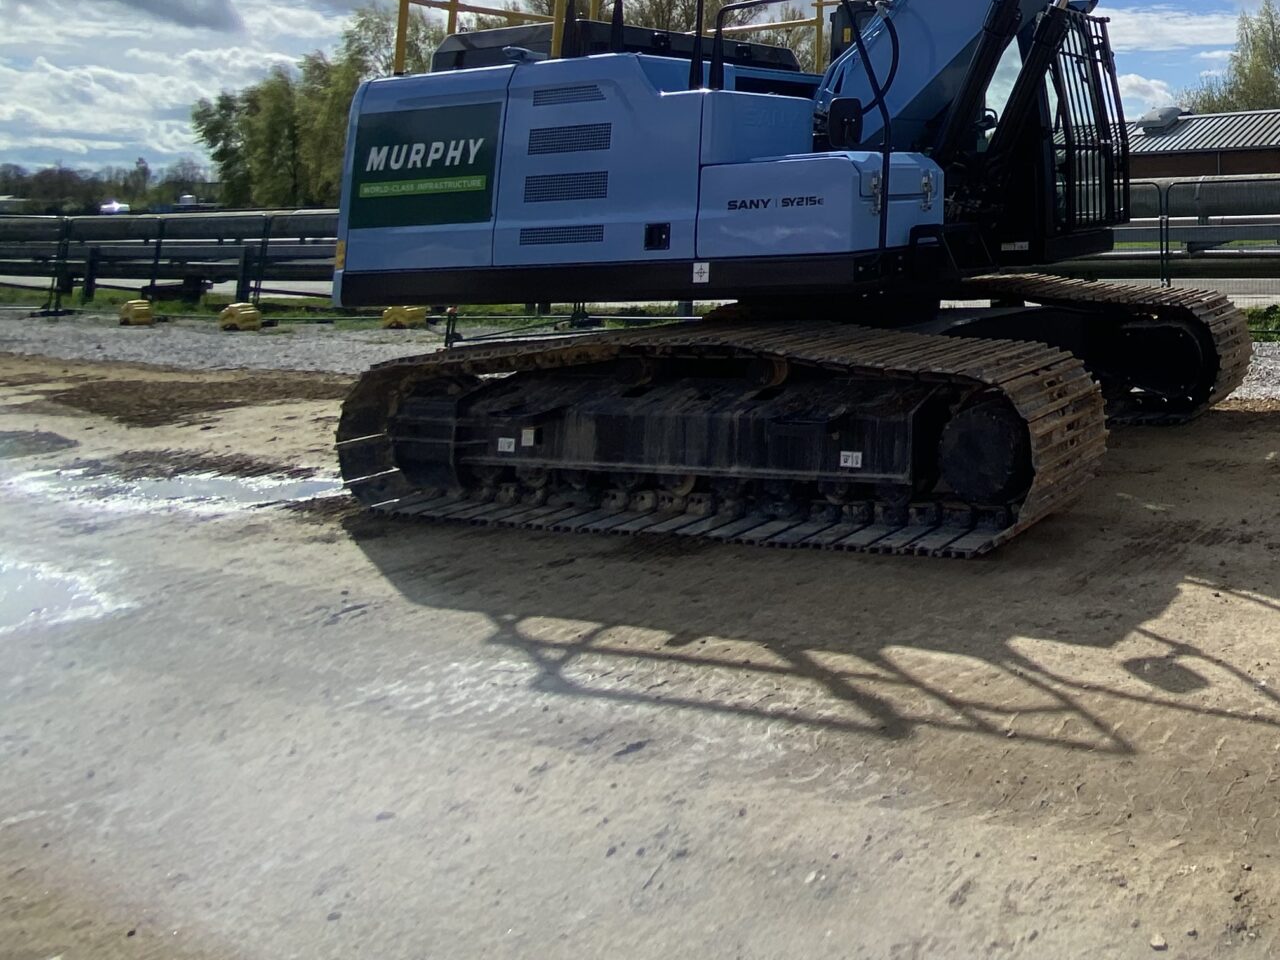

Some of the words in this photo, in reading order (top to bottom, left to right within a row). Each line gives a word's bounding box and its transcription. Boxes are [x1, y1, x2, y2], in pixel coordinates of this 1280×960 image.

[365, 138, 485, 172] MURPHY
[363, 184, 414, 195] WORLD-CLASS
[417, 178, 482, 192] INFRASTRUCTURE
[727, 198, 771, 211] SANY
